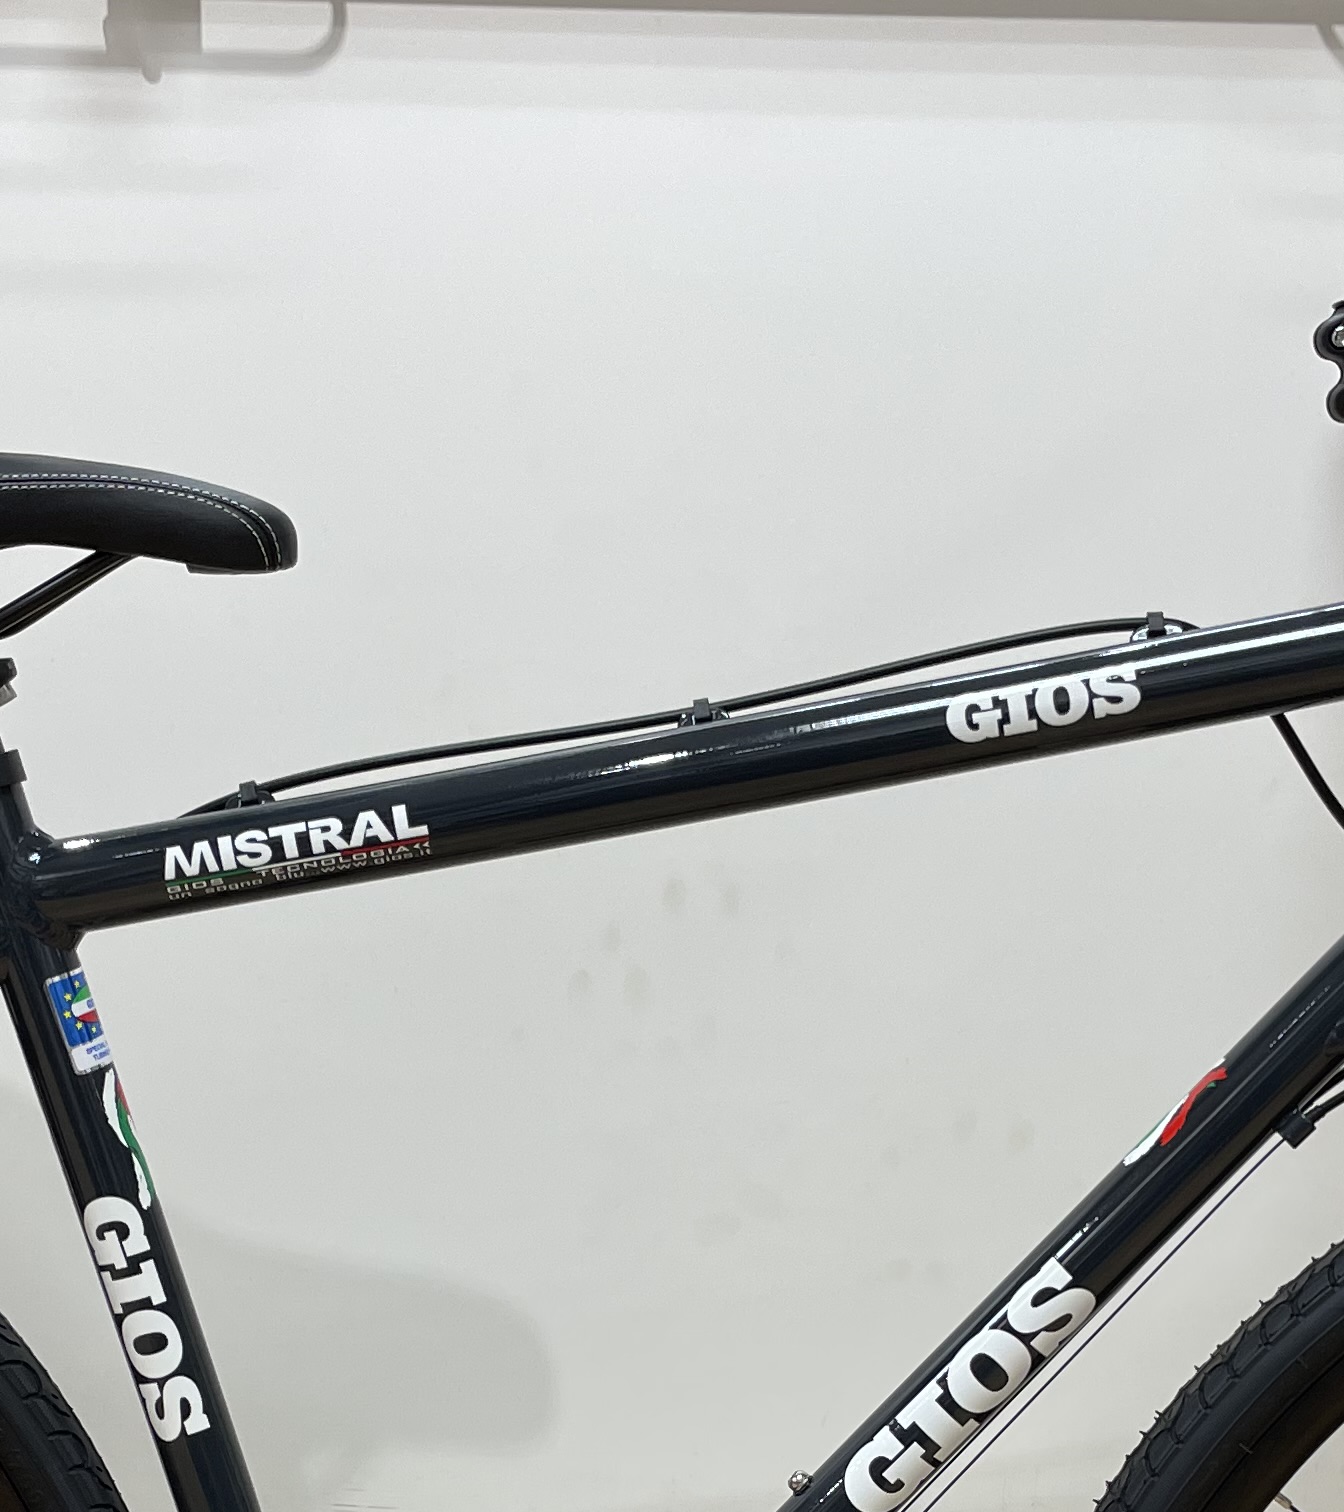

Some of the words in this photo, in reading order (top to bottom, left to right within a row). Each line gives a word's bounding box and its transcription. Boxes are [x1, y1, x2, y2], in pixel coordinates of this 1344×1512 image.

[945, 662, 1142, 744] GIOS
[164, 803, 430, 882] MISTRAL
[166, 877, 224, 894] GIOS
[256, 845, 410, 877] TECNOLOGIA
[82, 1195, 211, 1443] GIOS
